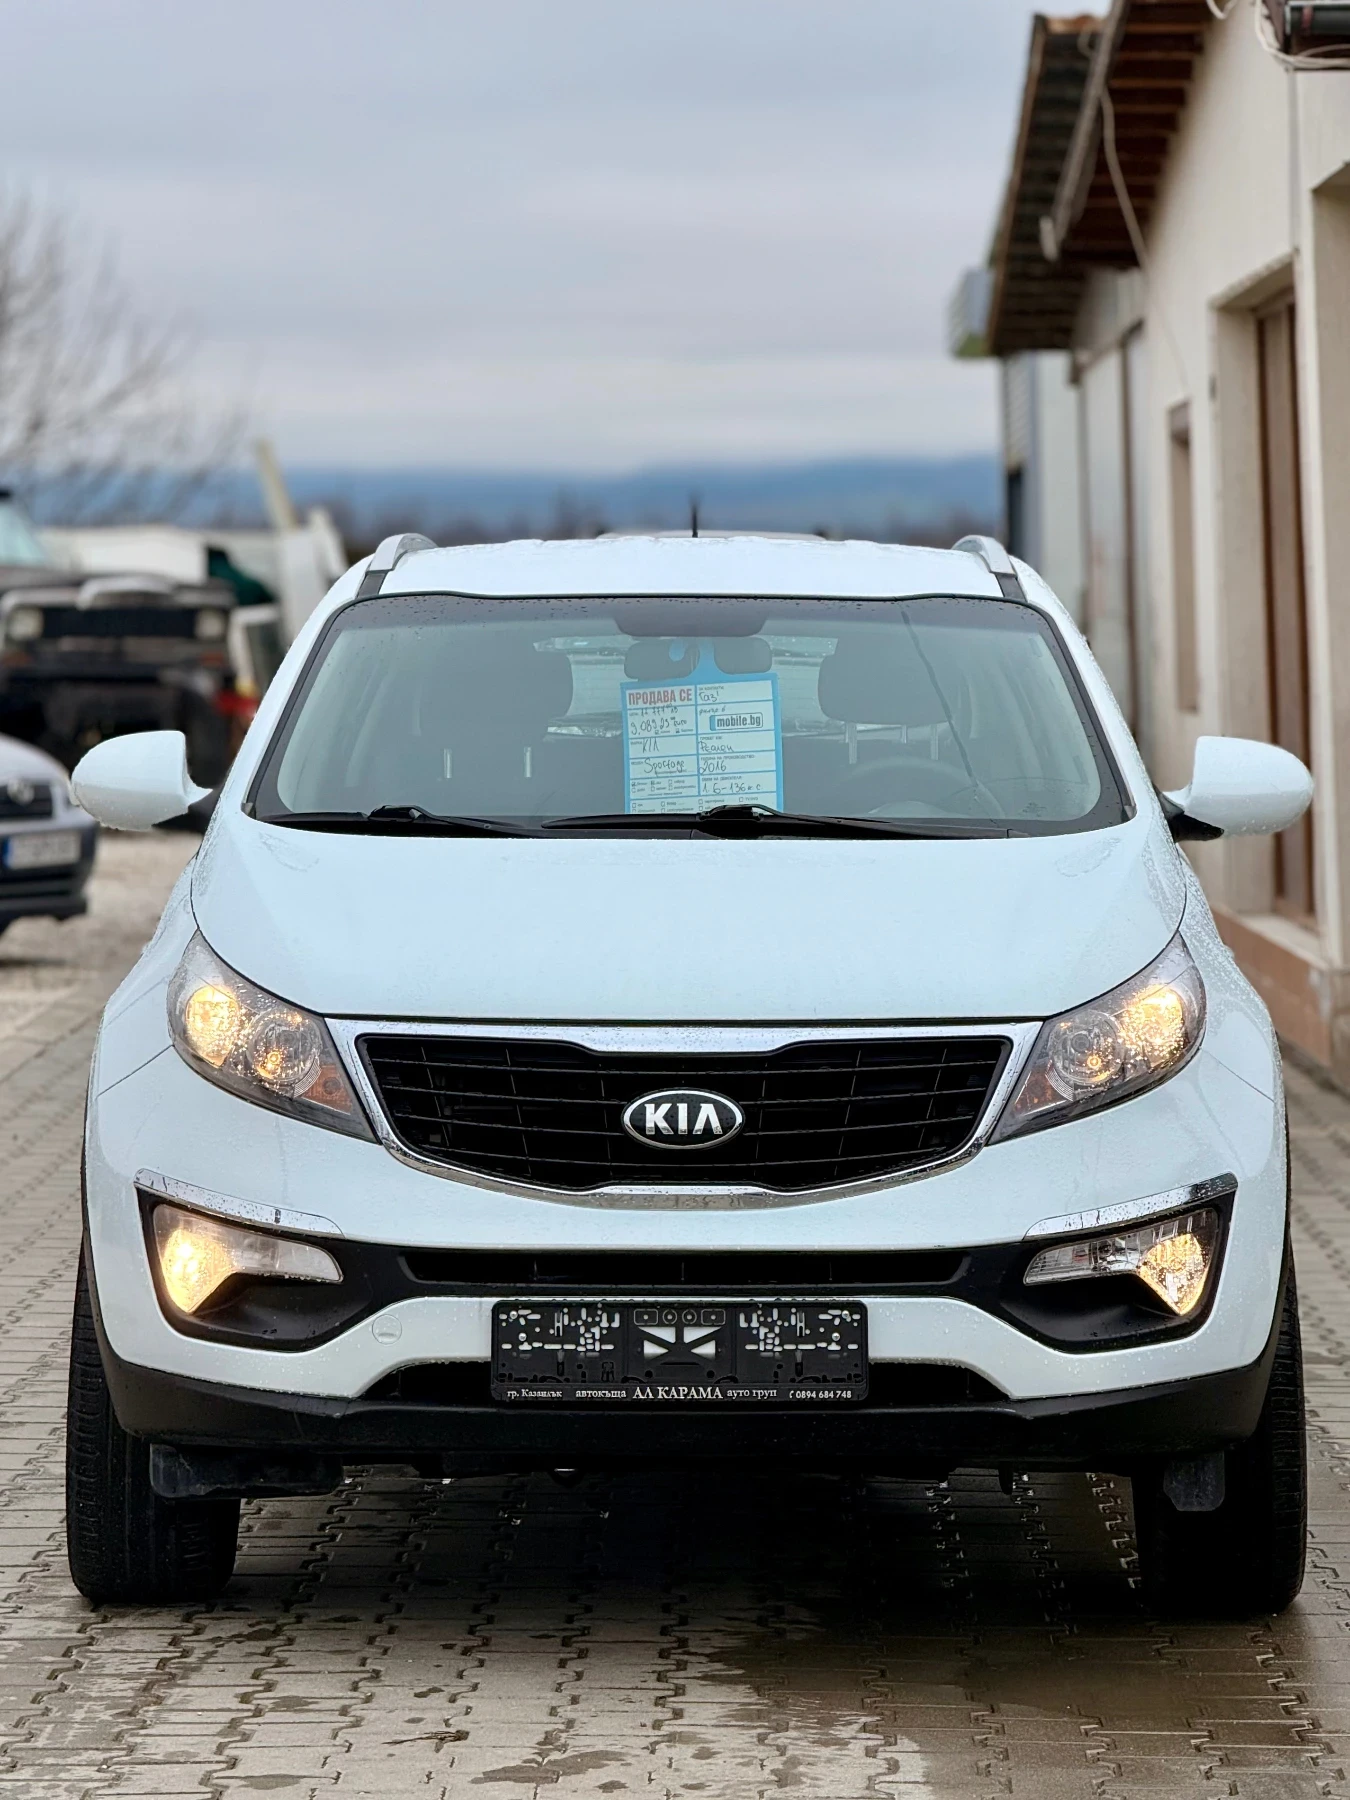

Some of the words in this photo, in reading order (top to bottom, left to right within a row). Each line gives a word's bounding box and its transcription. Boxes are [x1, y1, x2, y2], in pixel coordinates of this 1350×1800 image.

[628, 689, 676, 706] ПРОДАВА
[679, 688, 693, 702] СЕ
[716, 714, 761, 728] mobile.bg
[699, 760, 726, 775] 2016
[644, 1103, 723, 1135] KIA
[507, 1389, 519, 1399] гр.
[521, 1389, 562, 1398] Казанлък
[575, 1389, 627, 1399] автокъща
[632, 1386, 654, 1399] АЛ
[657, 1386, 723, 1399] КАРАМА
[727, 1388, 750, 1398] ауто
[752, 1388, 778, 1398] груп
[795, 1390, 816, 1399] 0894
[818, 1390, 834, 1399] 684
[835, 1390, 852, 1399] 748
